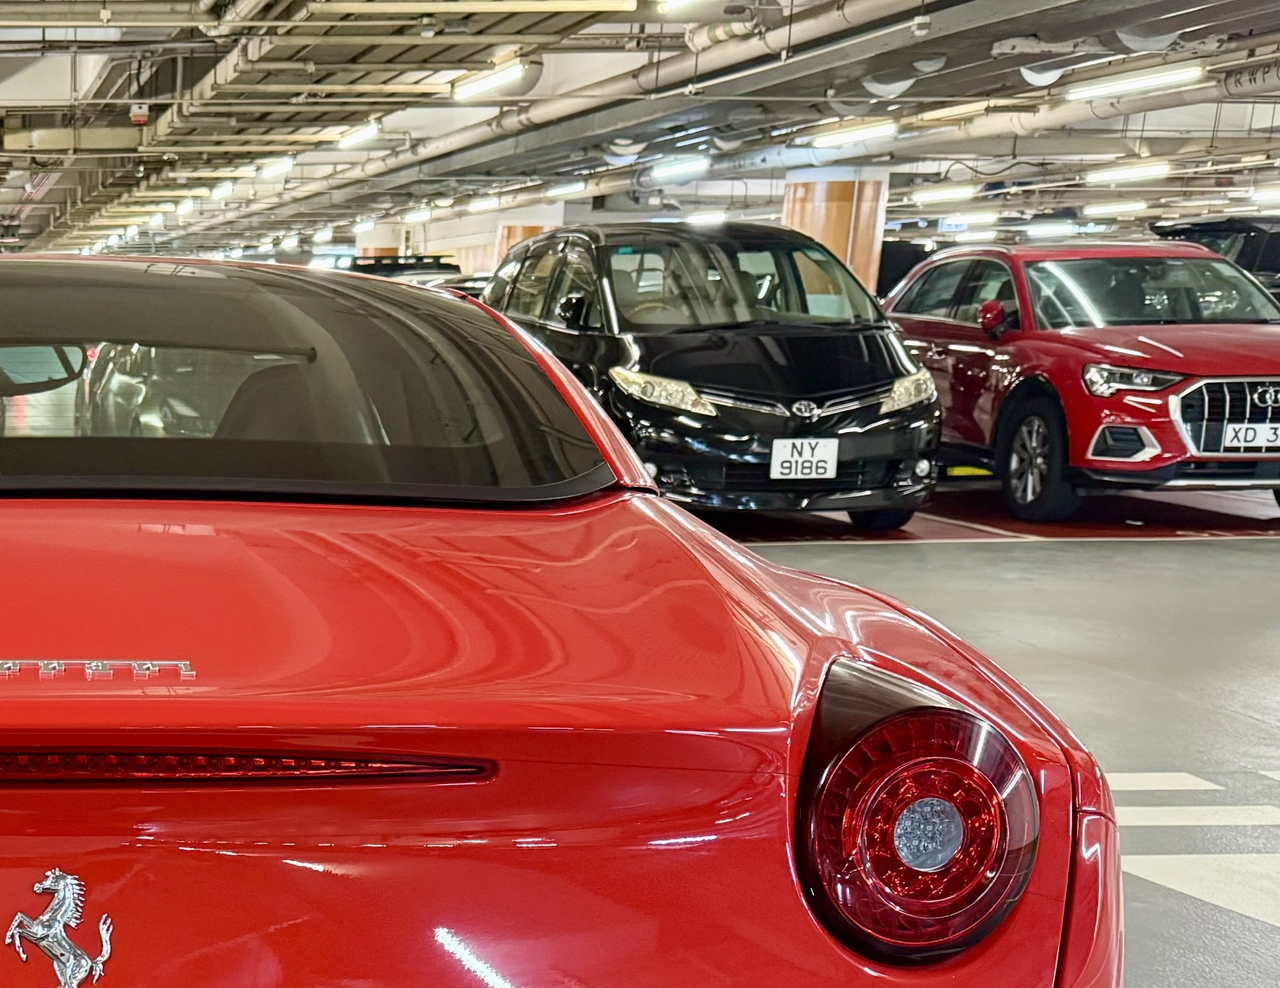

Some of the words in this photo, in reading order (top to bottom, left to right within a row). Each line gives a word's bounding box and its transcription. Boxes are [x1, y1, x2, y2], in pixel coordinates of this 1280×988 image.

[1229, 426, 1257, 443] XD
[790, 441, 820, 458] NY
[780, 459, 828, 476] 9186
